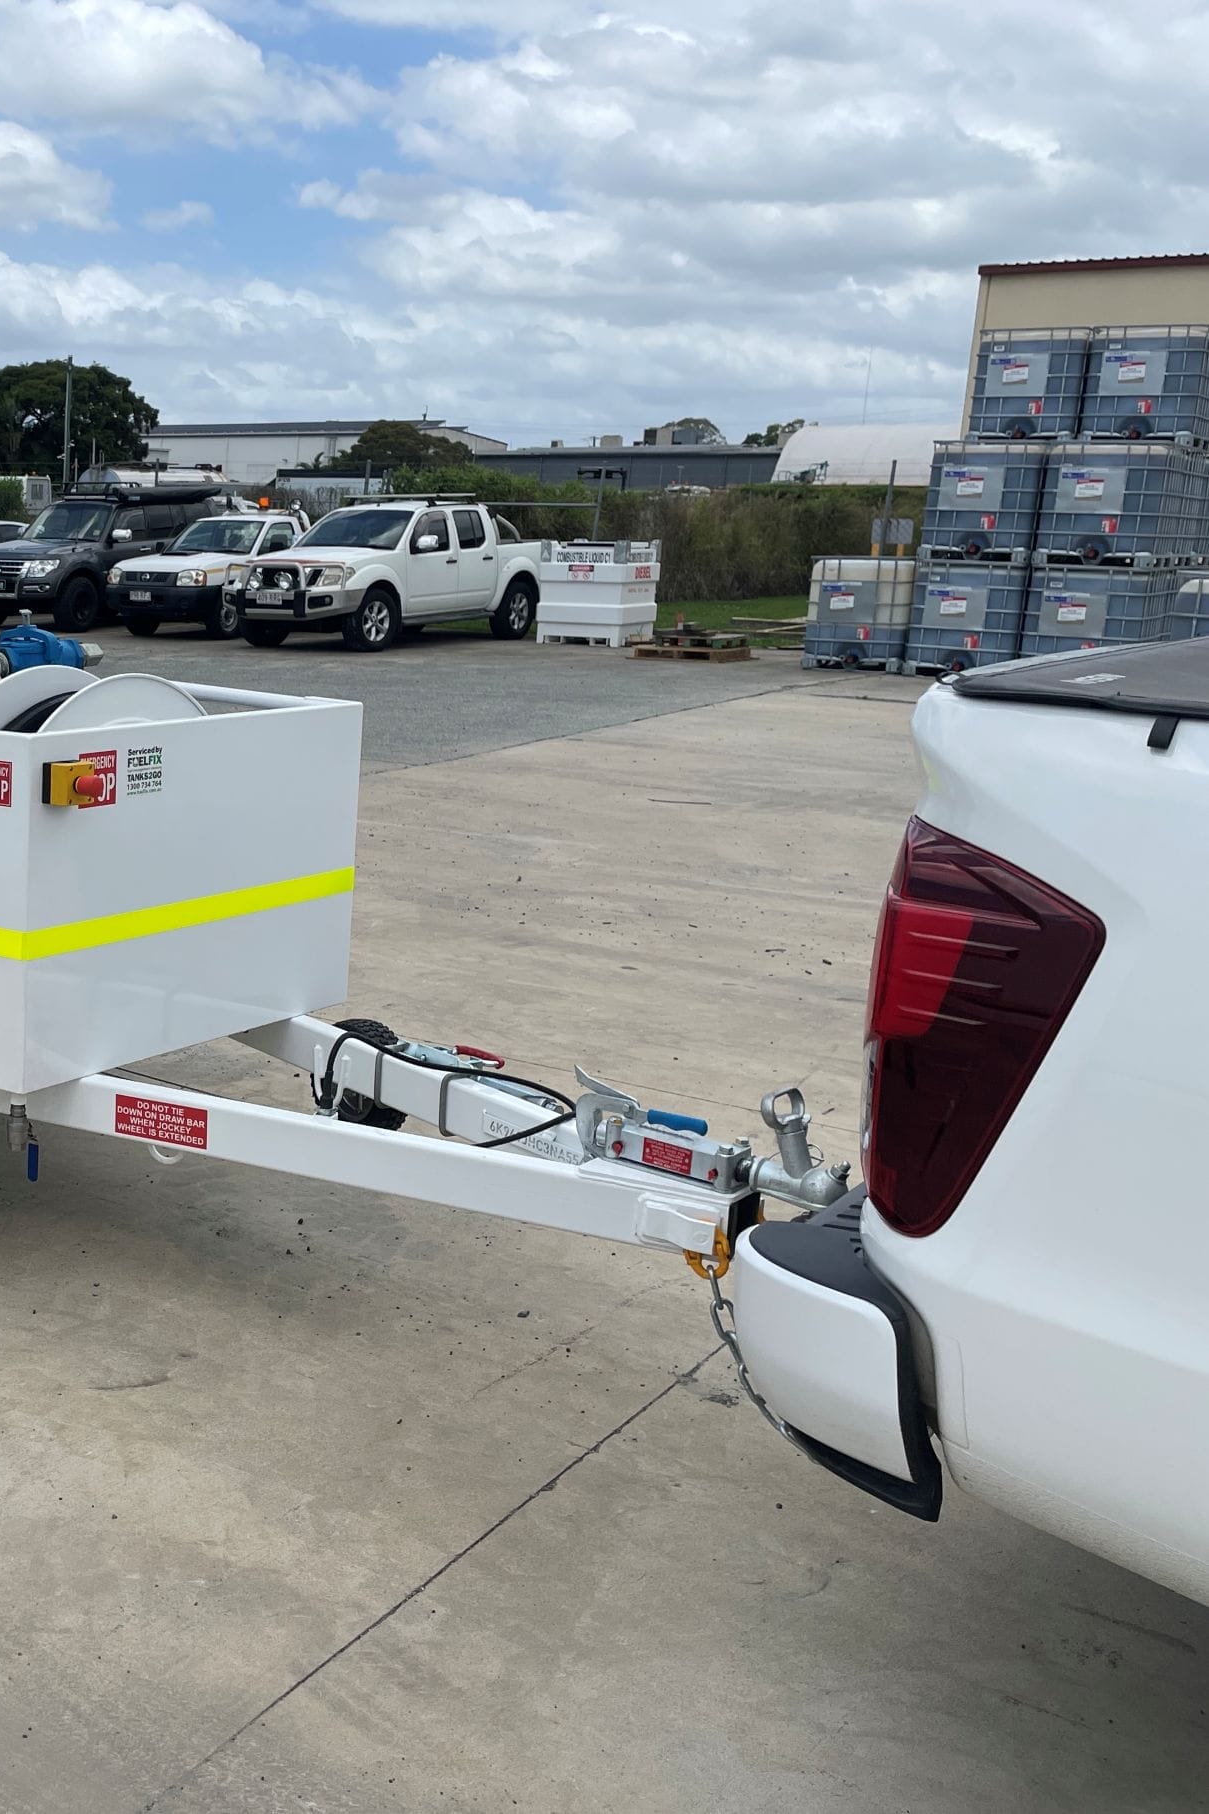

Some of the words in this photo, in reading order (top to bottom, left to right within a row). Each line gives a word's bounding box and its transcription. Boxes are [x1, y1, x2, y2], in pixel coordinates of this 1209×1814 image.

[155, 746, 162, 754] by
[127, 771, 162, 782] TANKS2GO
[117, 1105, 143, 1118] DOWN
[144, 1111, 157, 1120] ON
[159, 1113, 185, 1125] DRAW
[186, 1118, 205, 1129] BAR
[137, 1100, 150, 1110] DO
[151, 1103, 169, 1114] NOT
[171, 1107, 184, 1117] TIE
[117, 1122, 147, 1136] WHEEL
[148, 1128, 157, 1137] IS
[158, 1131, 204, 1146] EXTENDED
[130, 1116, 155, 1128] WHEN
[156, 1121, 192, 1135] JOCKEY
